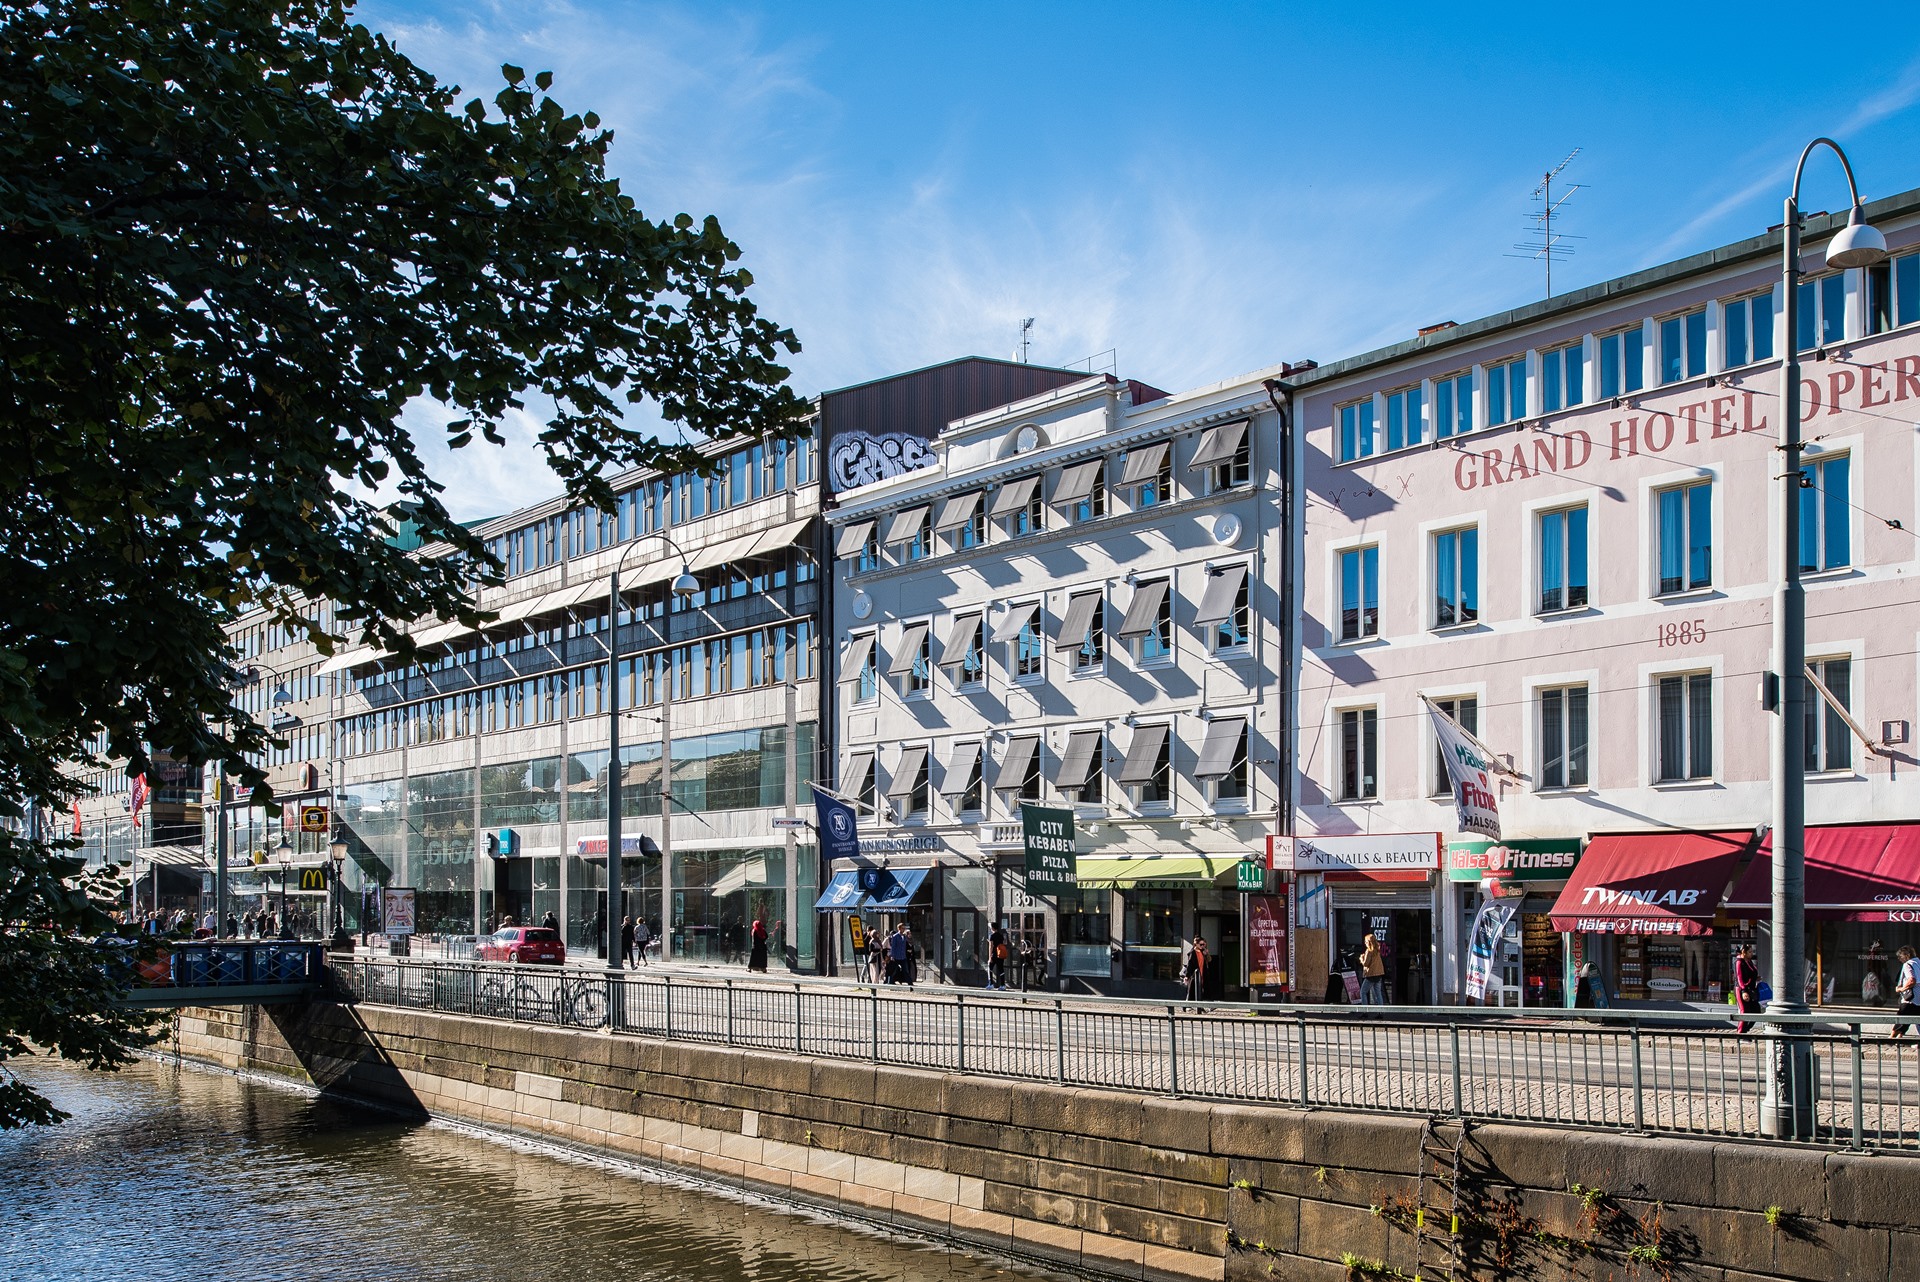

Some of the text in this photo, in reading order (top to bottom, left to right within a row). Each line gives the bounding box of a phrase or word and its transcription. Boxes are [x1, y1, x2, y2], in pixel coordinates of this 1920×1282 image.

[1454, 429, 1592, 491] GRAND
[1609, 391, 1767, 460] HOTEL
[1657, 618, 1706, 648] 1885
[1461, 781, 1498, 815] Fitne
[1040, 820, 1064, 836] CITY
[896, 837, 938, 850] SVERIGE
[1028, 835, 1076, 853] KEBABEN
[1042, 856, 1069, 869] PIZZA
[1315, 851, 1433, 865] NT NAILS & BEAUTY
[1451, 849, 1489, 869] Hälsa
[1503, 849, 1575, 868] Fitness
[1028, 869, 1055, 882] GRILL
[1057, 872, 1063, 883] &
[1238, 863, 1262, 880] CITY
[1173, 880, 1195, 888] BAR
[1239, 880, 1249, 888] KÖK
[1014, 891, 1031, 906] 36
[1581, 887, 1700, 905] TWINLAB
[1370, 916, 1389, 928] NYTT
[1577, 919, 1616, 931] Hälsa
[1630, 919, 1682, 932] Fitness
[1373, 929, 1387, 941] SET
